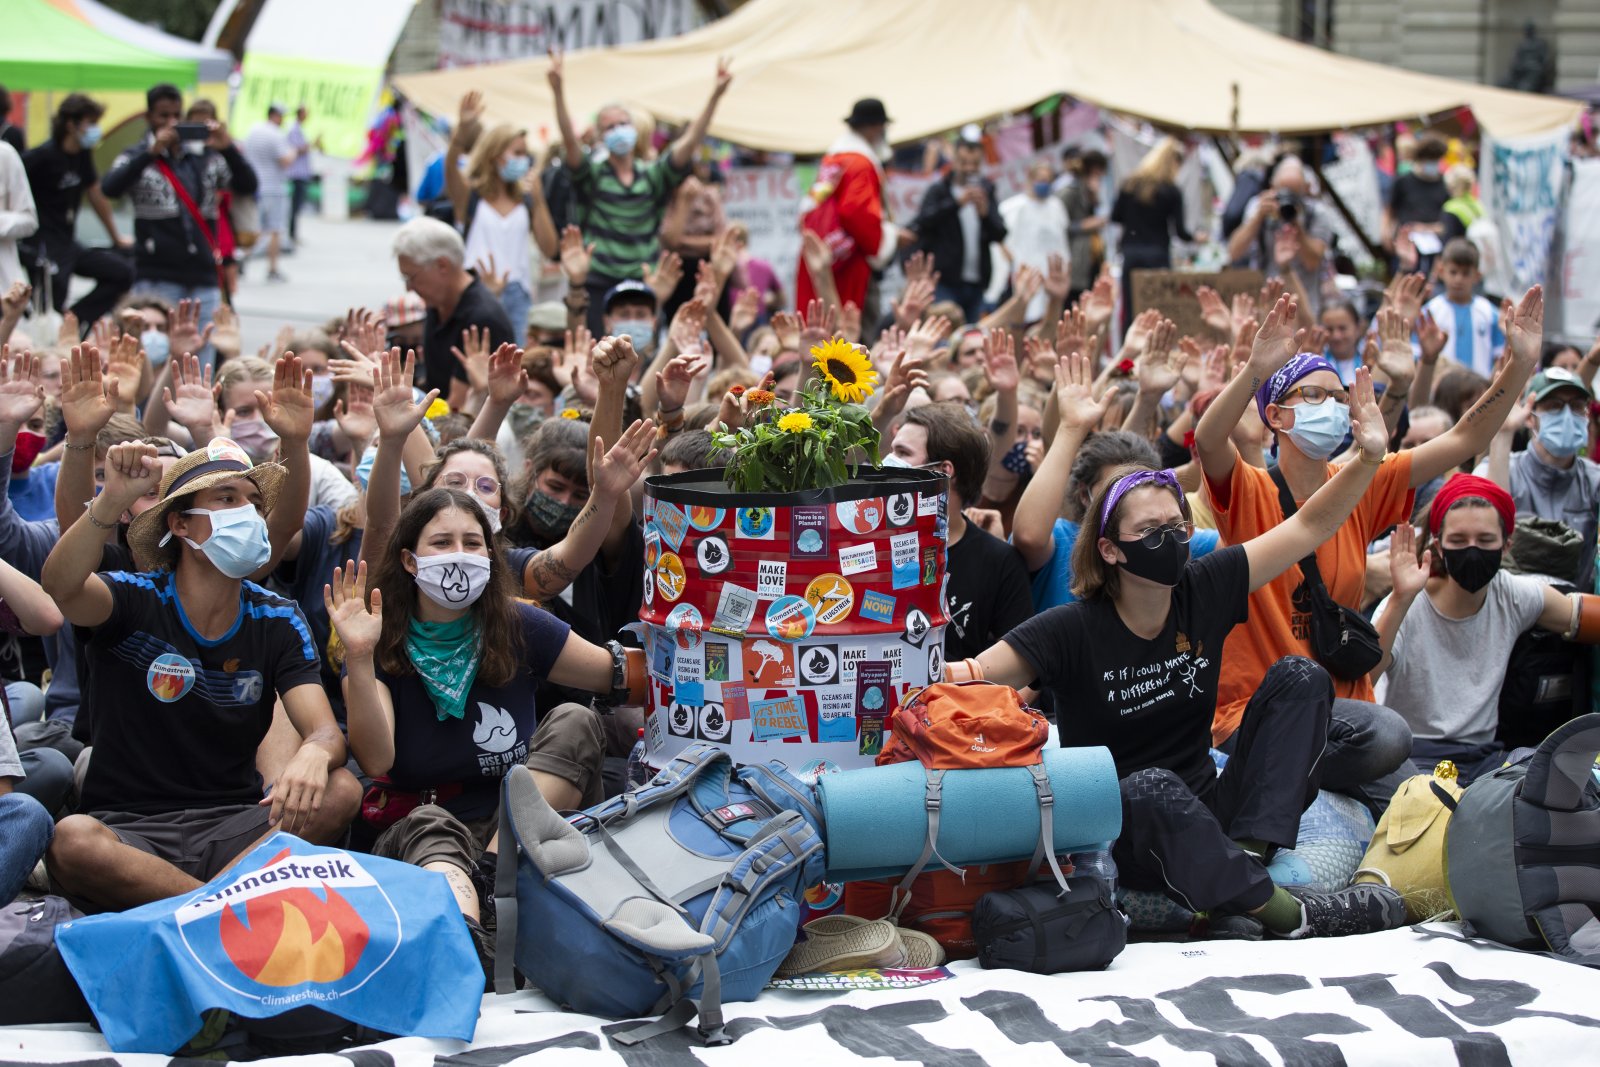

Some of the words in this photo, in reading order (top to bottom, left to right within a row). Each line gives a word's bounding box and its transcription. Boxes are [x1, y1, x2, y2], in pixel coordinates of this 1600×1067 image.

[894, 540, 909, 549] OCEANS
[895, 549, 908, 557] RISING
[760, 565, 785, 575] MAKE
[760, 575, 784, 586] LOVE
[769, 601, 803, 623] Klimastreik
[823, 598, 851, 621] FLUGSTREIK
[864, 600, 892, 616] NOW!
[843, 650, 866, 659] MAKE
[883, 649, 902, 659] MAKE
[154, 663, 190, 674] Klimastreik
[782, 665, 792, 673] JA
[1104, 671, 1115, 682] AS
[1120, 667, 1128, 680] IF
[1131, 667, 1134, 679] I
[1136, 663, 1161, 677] COULD
[1165, 652, 1190, 669] MAKE
[1108, 690, 1115, 701] A
[1121, 672, 1171, 701] DIFFERENCE
[756, 706, 772, 718] IT'S
[775, 698, 798, 713] TIME
[754, 718, 767, 726] TO
[769, 715, 807, 730] REBEL
[479, 755, 502, 767] RISE
[502, 751, 514, 763] UP
[514, 745, 527, 759] FOR
[768, 976, 874, 985] MEINSAM
[261, 989, 339, 1005] climatestrike.ch
